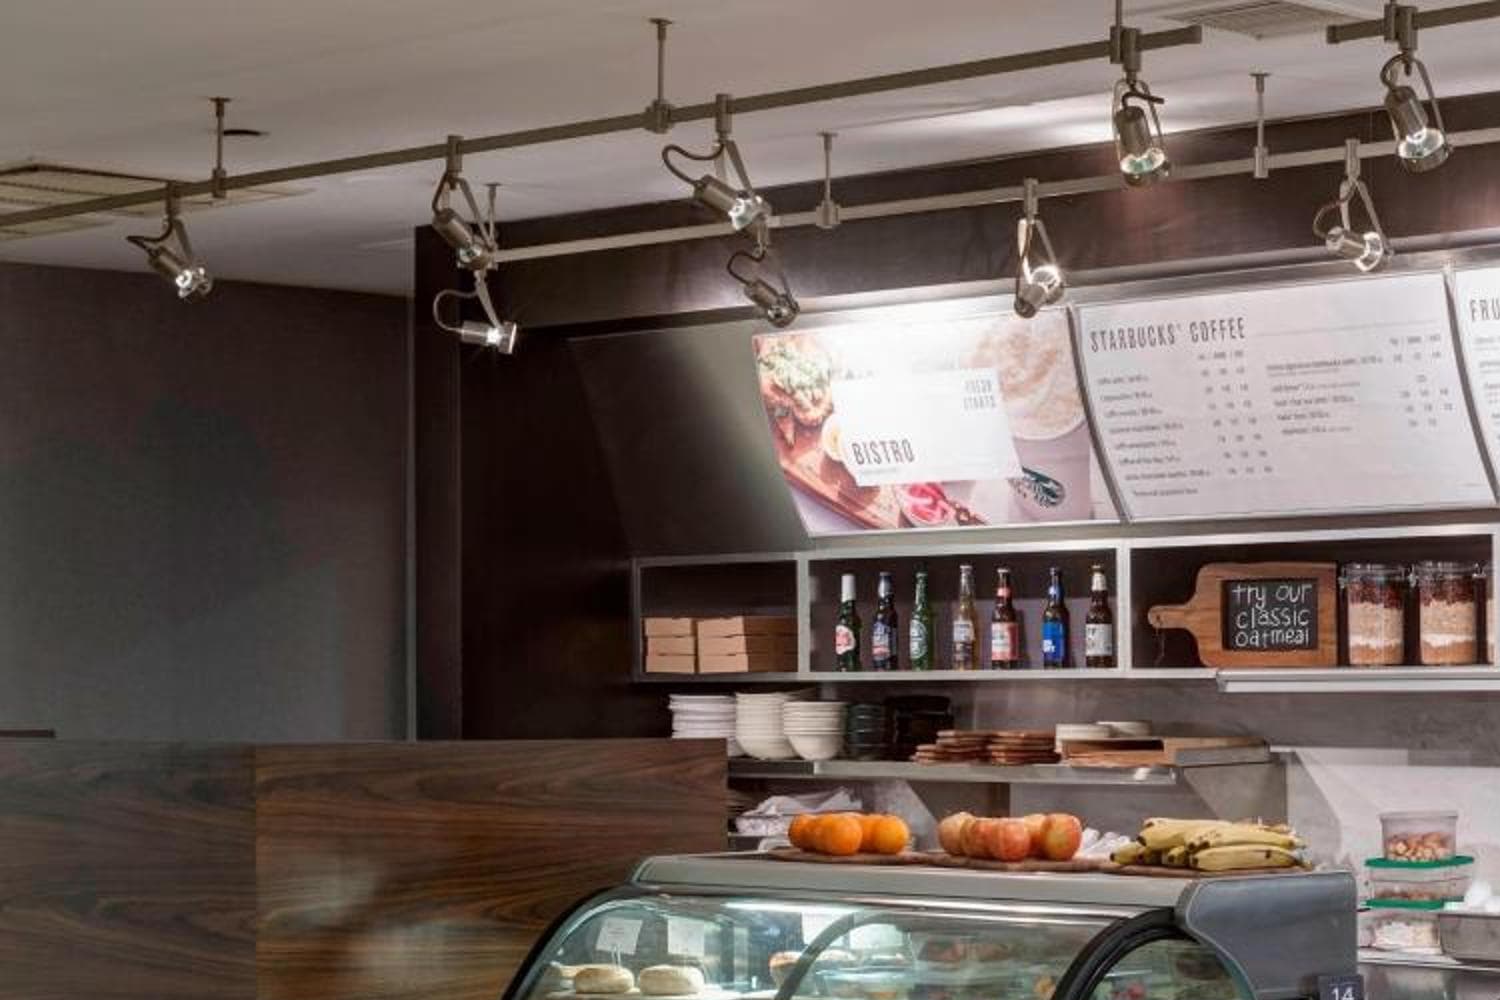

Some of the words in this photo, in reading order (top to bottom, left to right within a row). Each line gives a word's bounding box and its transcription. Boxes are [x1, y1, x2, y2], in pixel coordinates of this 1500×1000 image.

[1189, 317, 1245, 344] COFFEE
[851, 438, 915, 465] BISTRO
[1232, 584, 1266, 610] try
[1275, 583, 1312, 603] our
[1236, 604, 1311, 629] classic
[1235, 628, 1309, 648] oatmeal
